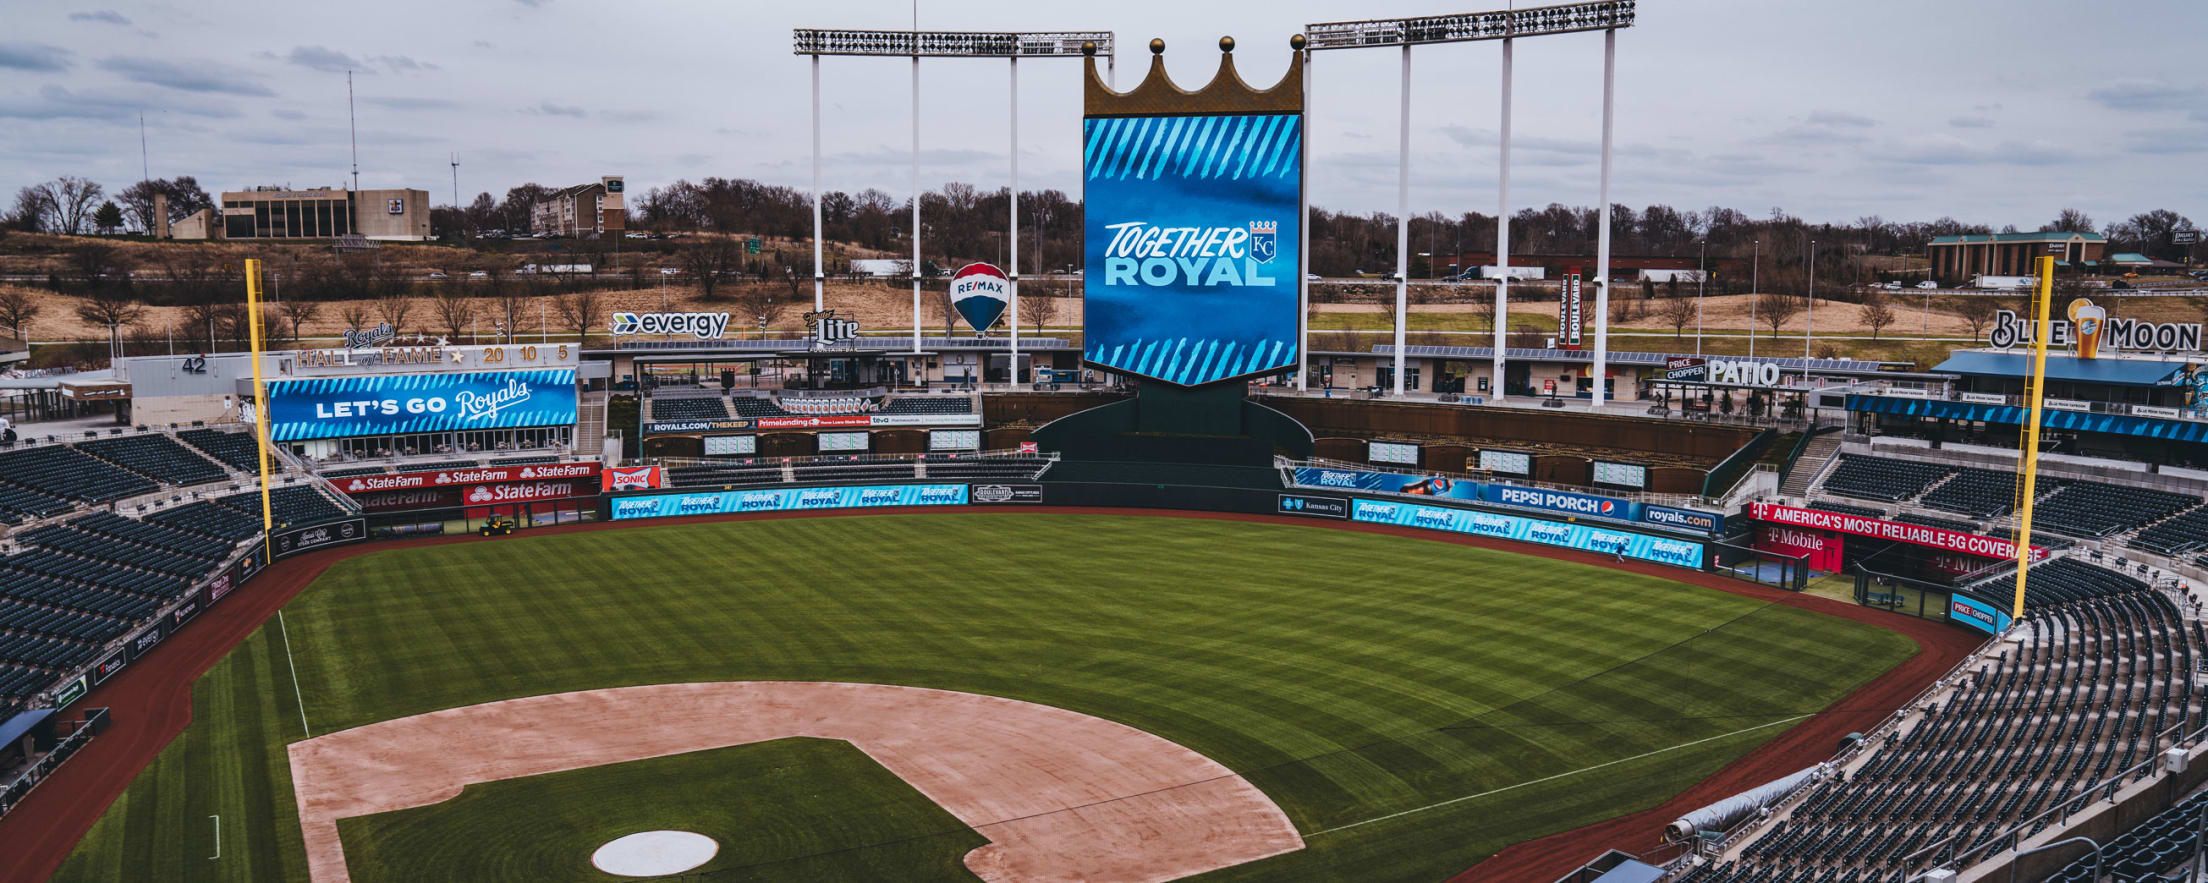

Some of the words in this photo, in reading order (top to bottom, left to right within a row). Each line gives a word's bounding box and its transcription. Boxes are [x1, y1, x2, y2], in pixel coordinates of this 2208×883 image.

[1104, 221, 1248, 259] TOGETHER
[1253, 236, 1273, 256] KC
[1105, 257, 1276, 287] ROYAL
[958, 281, 1003, 294] RE/MAX
[1571, 279, 1579, 339] BOULEVARD
[641, 313, 728, 338] evergy
[815, 318, 860, 345] Lite
[344, 322, 395, 349] Royals
[2109, 318, 2202, 351] MOON
[296, 349, 357, 368] HALL
[382, 347, 442, 365] FAME
[483, 347, 504, 363] 20
[520, 345, 537, 361] 10
[558, 344, 568, 360] 5
[182, 357, 206, 375] 42
[1668, 358, 1691, 369] PRICE
[1667, 367, 1704, 379] CHOPPER
[1709, 359, 1780, 386] PATIO
[406, 397, 447, 414] GO
[456, 379, 531, 421] Royals
[654, 421, 748, 431] ROYALS.COM/THEKEEP
[759, 418, 809, 427] PrimeLending
[616, 474, 646, 485] SONIC
[1320, 478, 1356, 487] ROYAL
[742, 499, 780, 508] ROYAL
[802, 497, 840, 505] ROYAL
[862, 495, 899, 503] ROYAL
[921, 494, 959, 502] ROYAL
[1502, 488, 1543, 506] PEPSI
[1546, 494, 1599, 513] PORCH
[619, 507, 658, 516] ROYAL
[681, 503, 720, 512] ROYAL
[1306, 502, 1328, 510] Kansas
[1329, 503, 1343, 512] City
[1359, 510, 1395, 520] ROYAL
[1416, 516, 1452, 527] ROYAL
[1649, 509, 1712, 527] royals.com
[1473, 523, 1510, 534] ROYAL
[1531, 531, 1569, 542] ROYAL
[1774, 508, 1842, 529] AMERICA'S
[1843, 518, 1881, 535] MOST
[1948, 534, 1966, 550] 5G
[1781, 528, 1823, 550] Mobile
[1652, 550, 1691, 563] ROYAL
[1955, 602, 1970, 615] PRICE
[1972, 609, 1994, 624] CHOPPER
